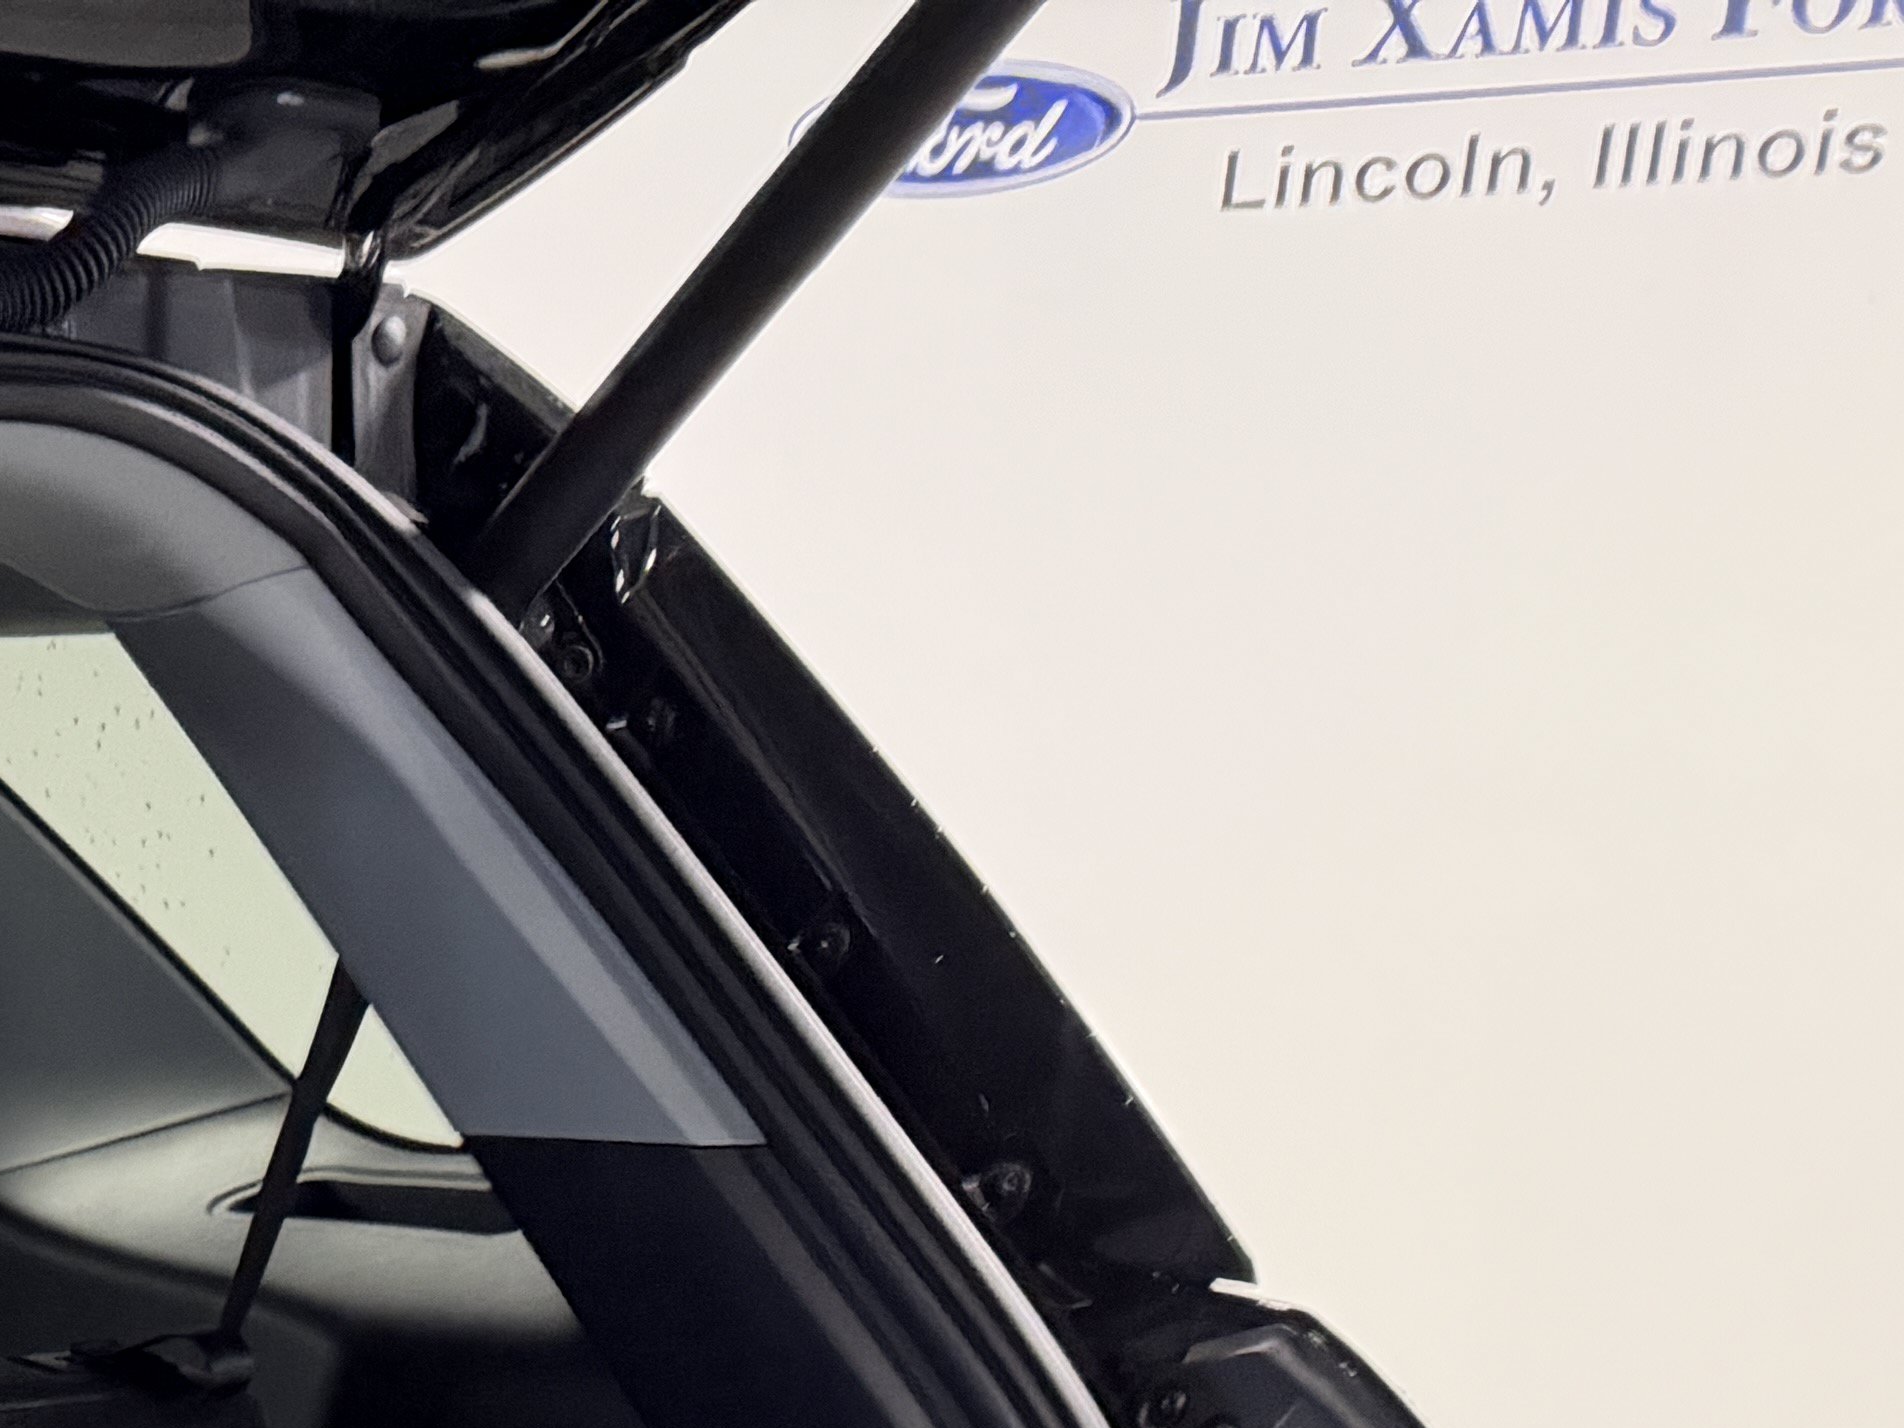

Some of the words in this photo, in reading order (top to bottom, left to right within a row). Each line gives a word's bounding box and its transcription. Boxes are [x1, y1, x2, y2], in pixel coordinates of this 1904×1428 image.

[904, 82, 1069, 177] ord
[1220, 131, 1556, 212] Lincoln,
[1592, 107, 1888, 188] Illinois
